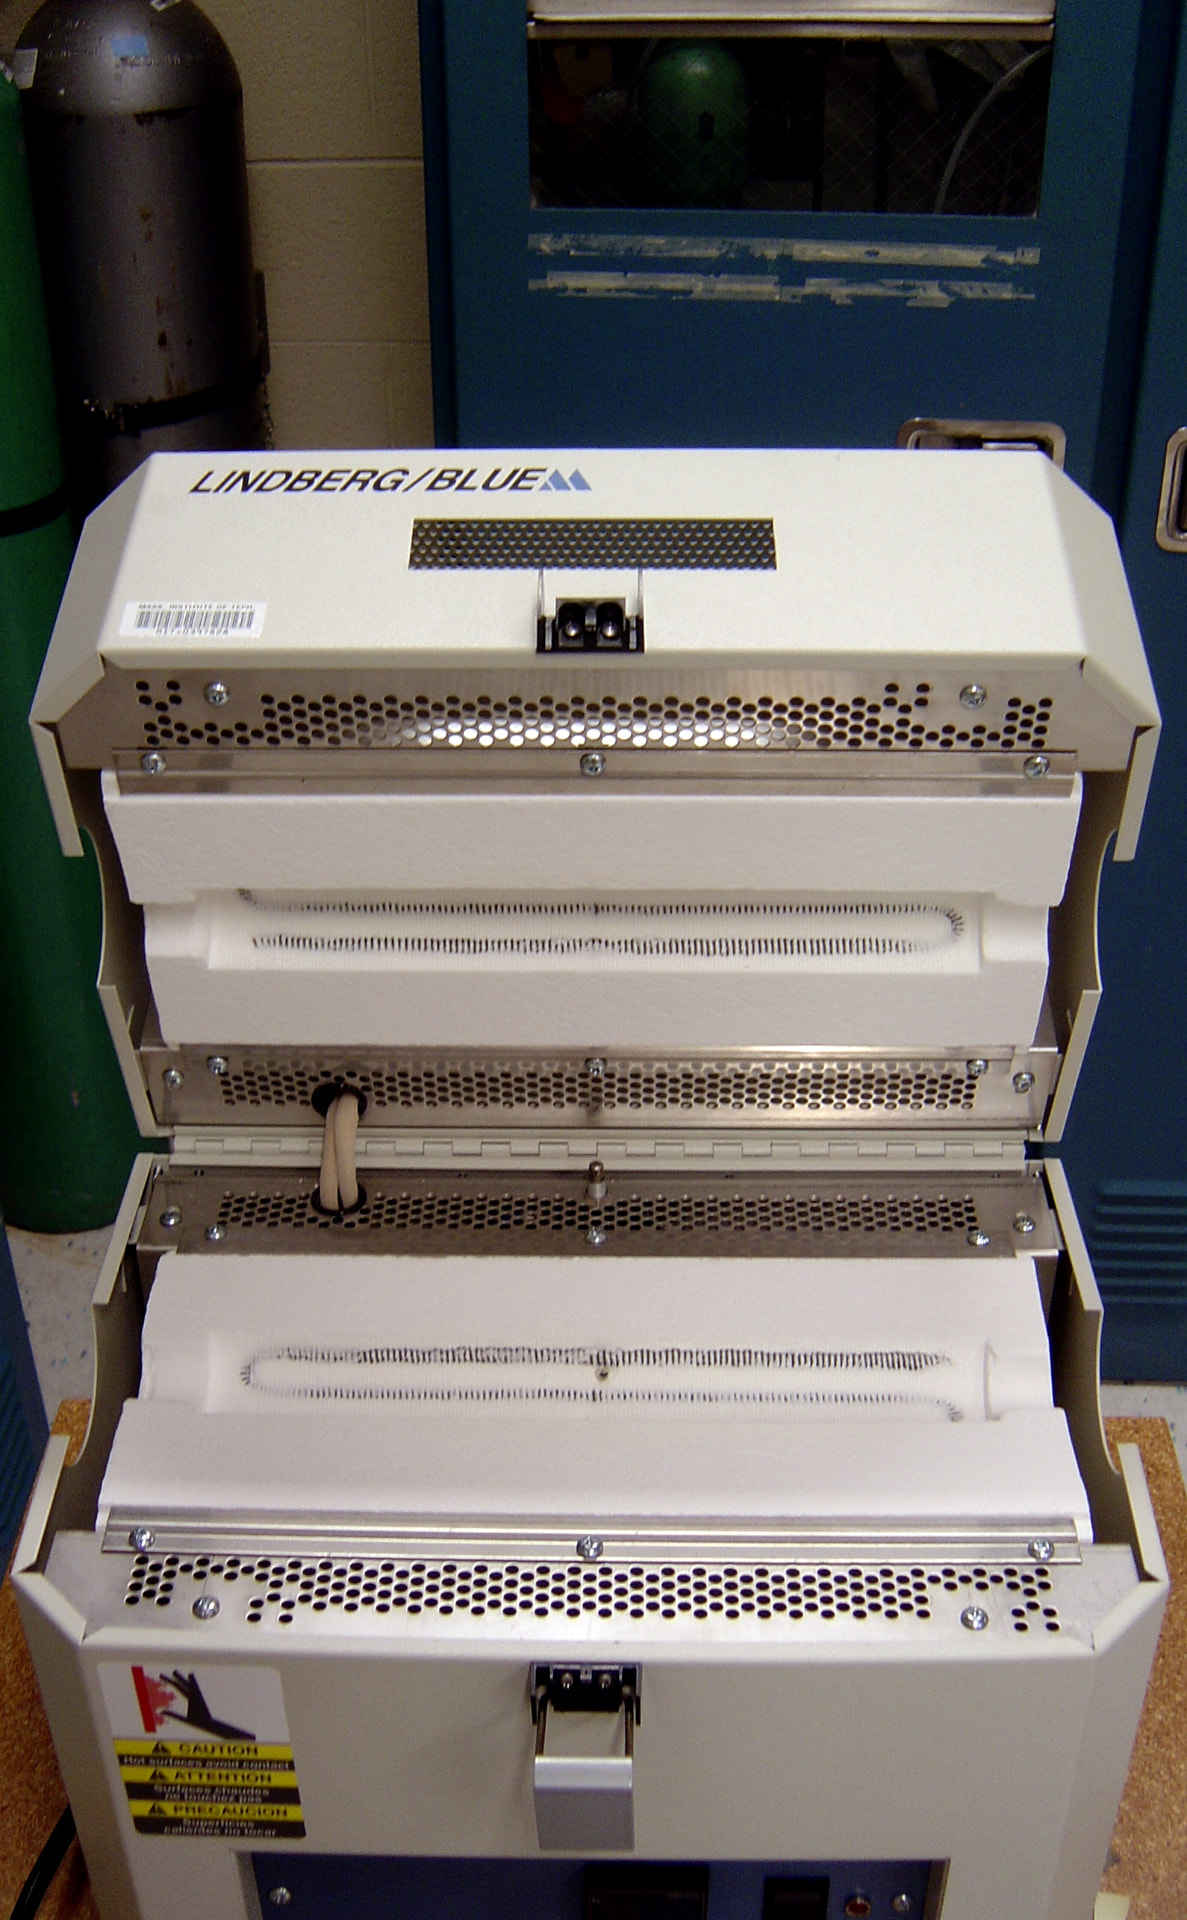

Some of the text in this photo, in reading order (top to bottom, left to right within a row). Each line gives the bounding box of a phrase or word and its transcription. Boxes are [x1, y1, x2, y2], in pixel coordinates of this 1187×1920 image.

[179, 1743, 258, 1756] CAUTION
[123, 1756, 289, 1770] Hot surfaces avoid contact
[175, 1770, 272, 1783] ATTENTION
[153, 1784, 270, 1796] Surfaces chaudes
[182, 1792, 235, 1802] touchez
[174, 1804, 288, 1818] PRECAUCION
[183, 1818, 255, 1829] Superficies
